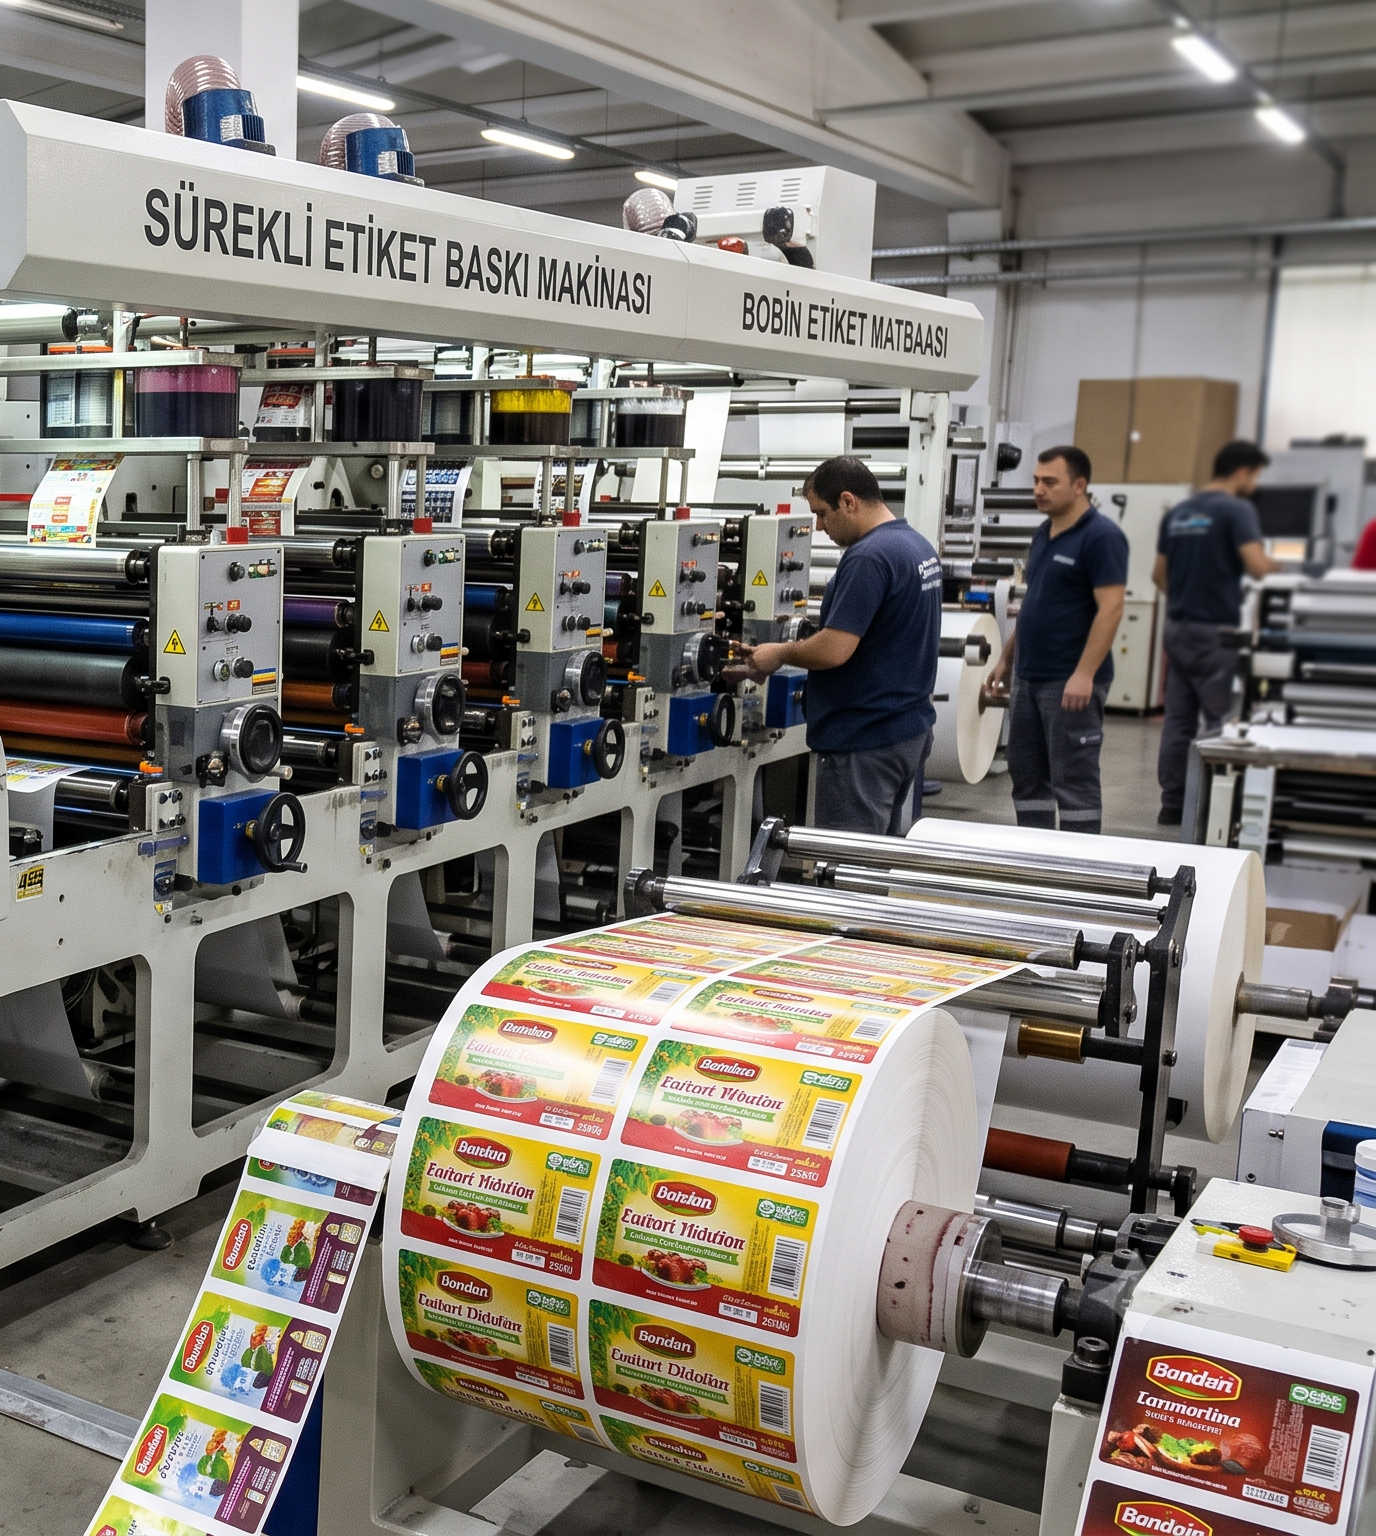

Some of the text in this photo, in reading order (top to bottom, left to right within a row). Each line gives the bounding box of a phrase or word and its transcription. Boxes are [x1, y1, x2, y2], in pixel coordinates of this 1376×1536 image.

[144, 180, 652, 315] SÜREKLİ ETİKET BASKI MAKİNASI
[742, 289, 948, 359] BOBİN ETİKET MATBAASI
[441, 1275, 489, 1298] Bondan
